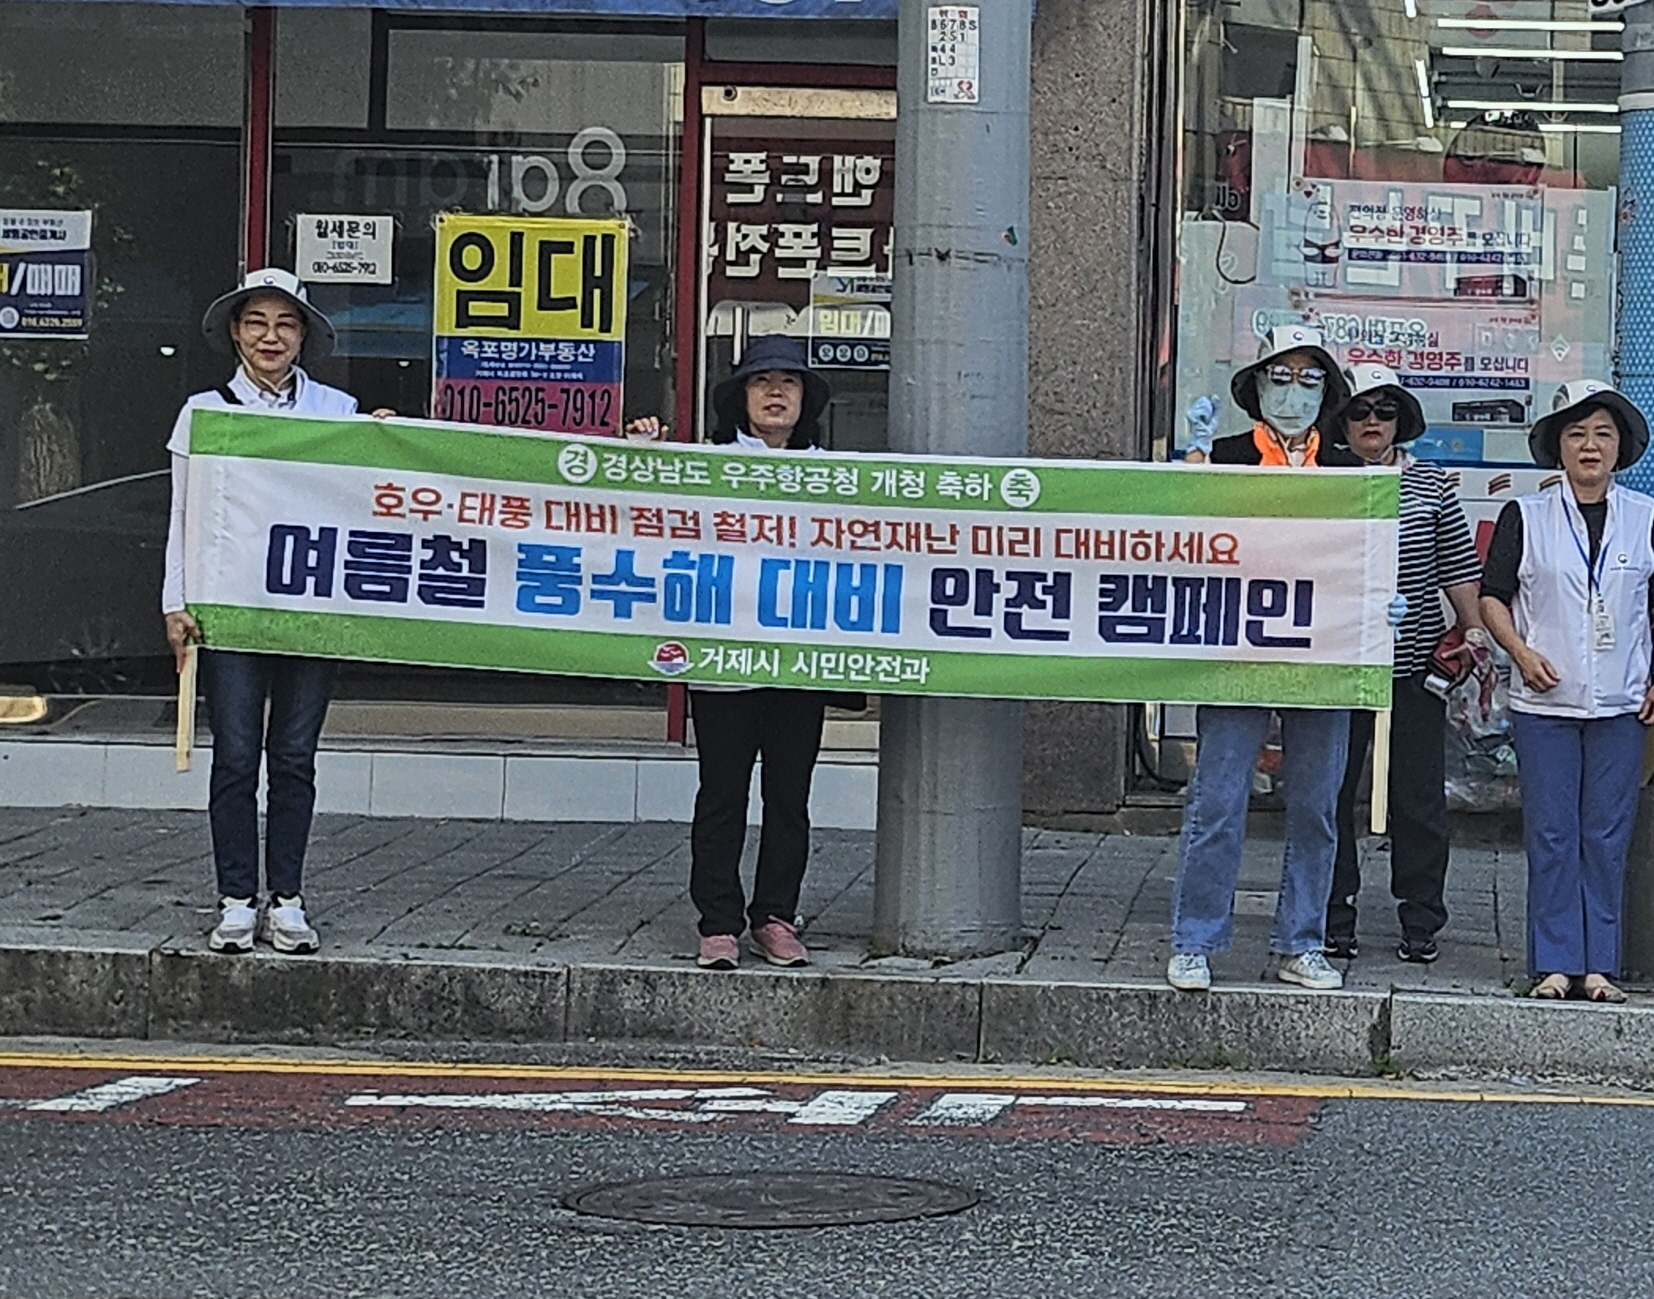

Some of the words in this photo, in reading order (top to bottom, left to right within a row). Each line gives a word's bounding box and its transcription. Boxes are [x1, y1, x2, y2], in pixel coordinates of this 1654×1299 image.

[1349, 225, 1406, 245] 우수한
[449, 230, 617, 335] 임대
[460, 339, 597, 363] 옥포명가부동산
[1407, 350, 1476, 372] 경영주를
[1480, 356, 1530, 373] 모십니다
[563, 449, 592, 477] 경
[603, 450, 712, 487] 경상남도
[720, 460, 860, 498] 우주항공청
[870, 468, 927, 498] 개청
[936, 469, 993, 502] 축하
[1007, 472, 1035, 500] 축
[371, 482, 532, 529] 호우·태풍
[544, 498, 618, 536] 대비
[629, 505, 702, 540] 점검
[712, 510, 797, 549] 철저!
[810, 517, 960, 556] 자연재난
[971, 524, 1043, 559] 미리
[1053, 526, 1241, 566] 대비하세요
[265, 523, 489, 610] 여름철
[515, 541, 733, 626] 풍수해
[757, 556, 905, 635] 대비
[929, 566, 1073, 641] 안전
[1098, 573, 1315, 650] 캠페인
[700, 647, 782, 678] 거제시
[790, 649, 931, 686] 시민안전과
